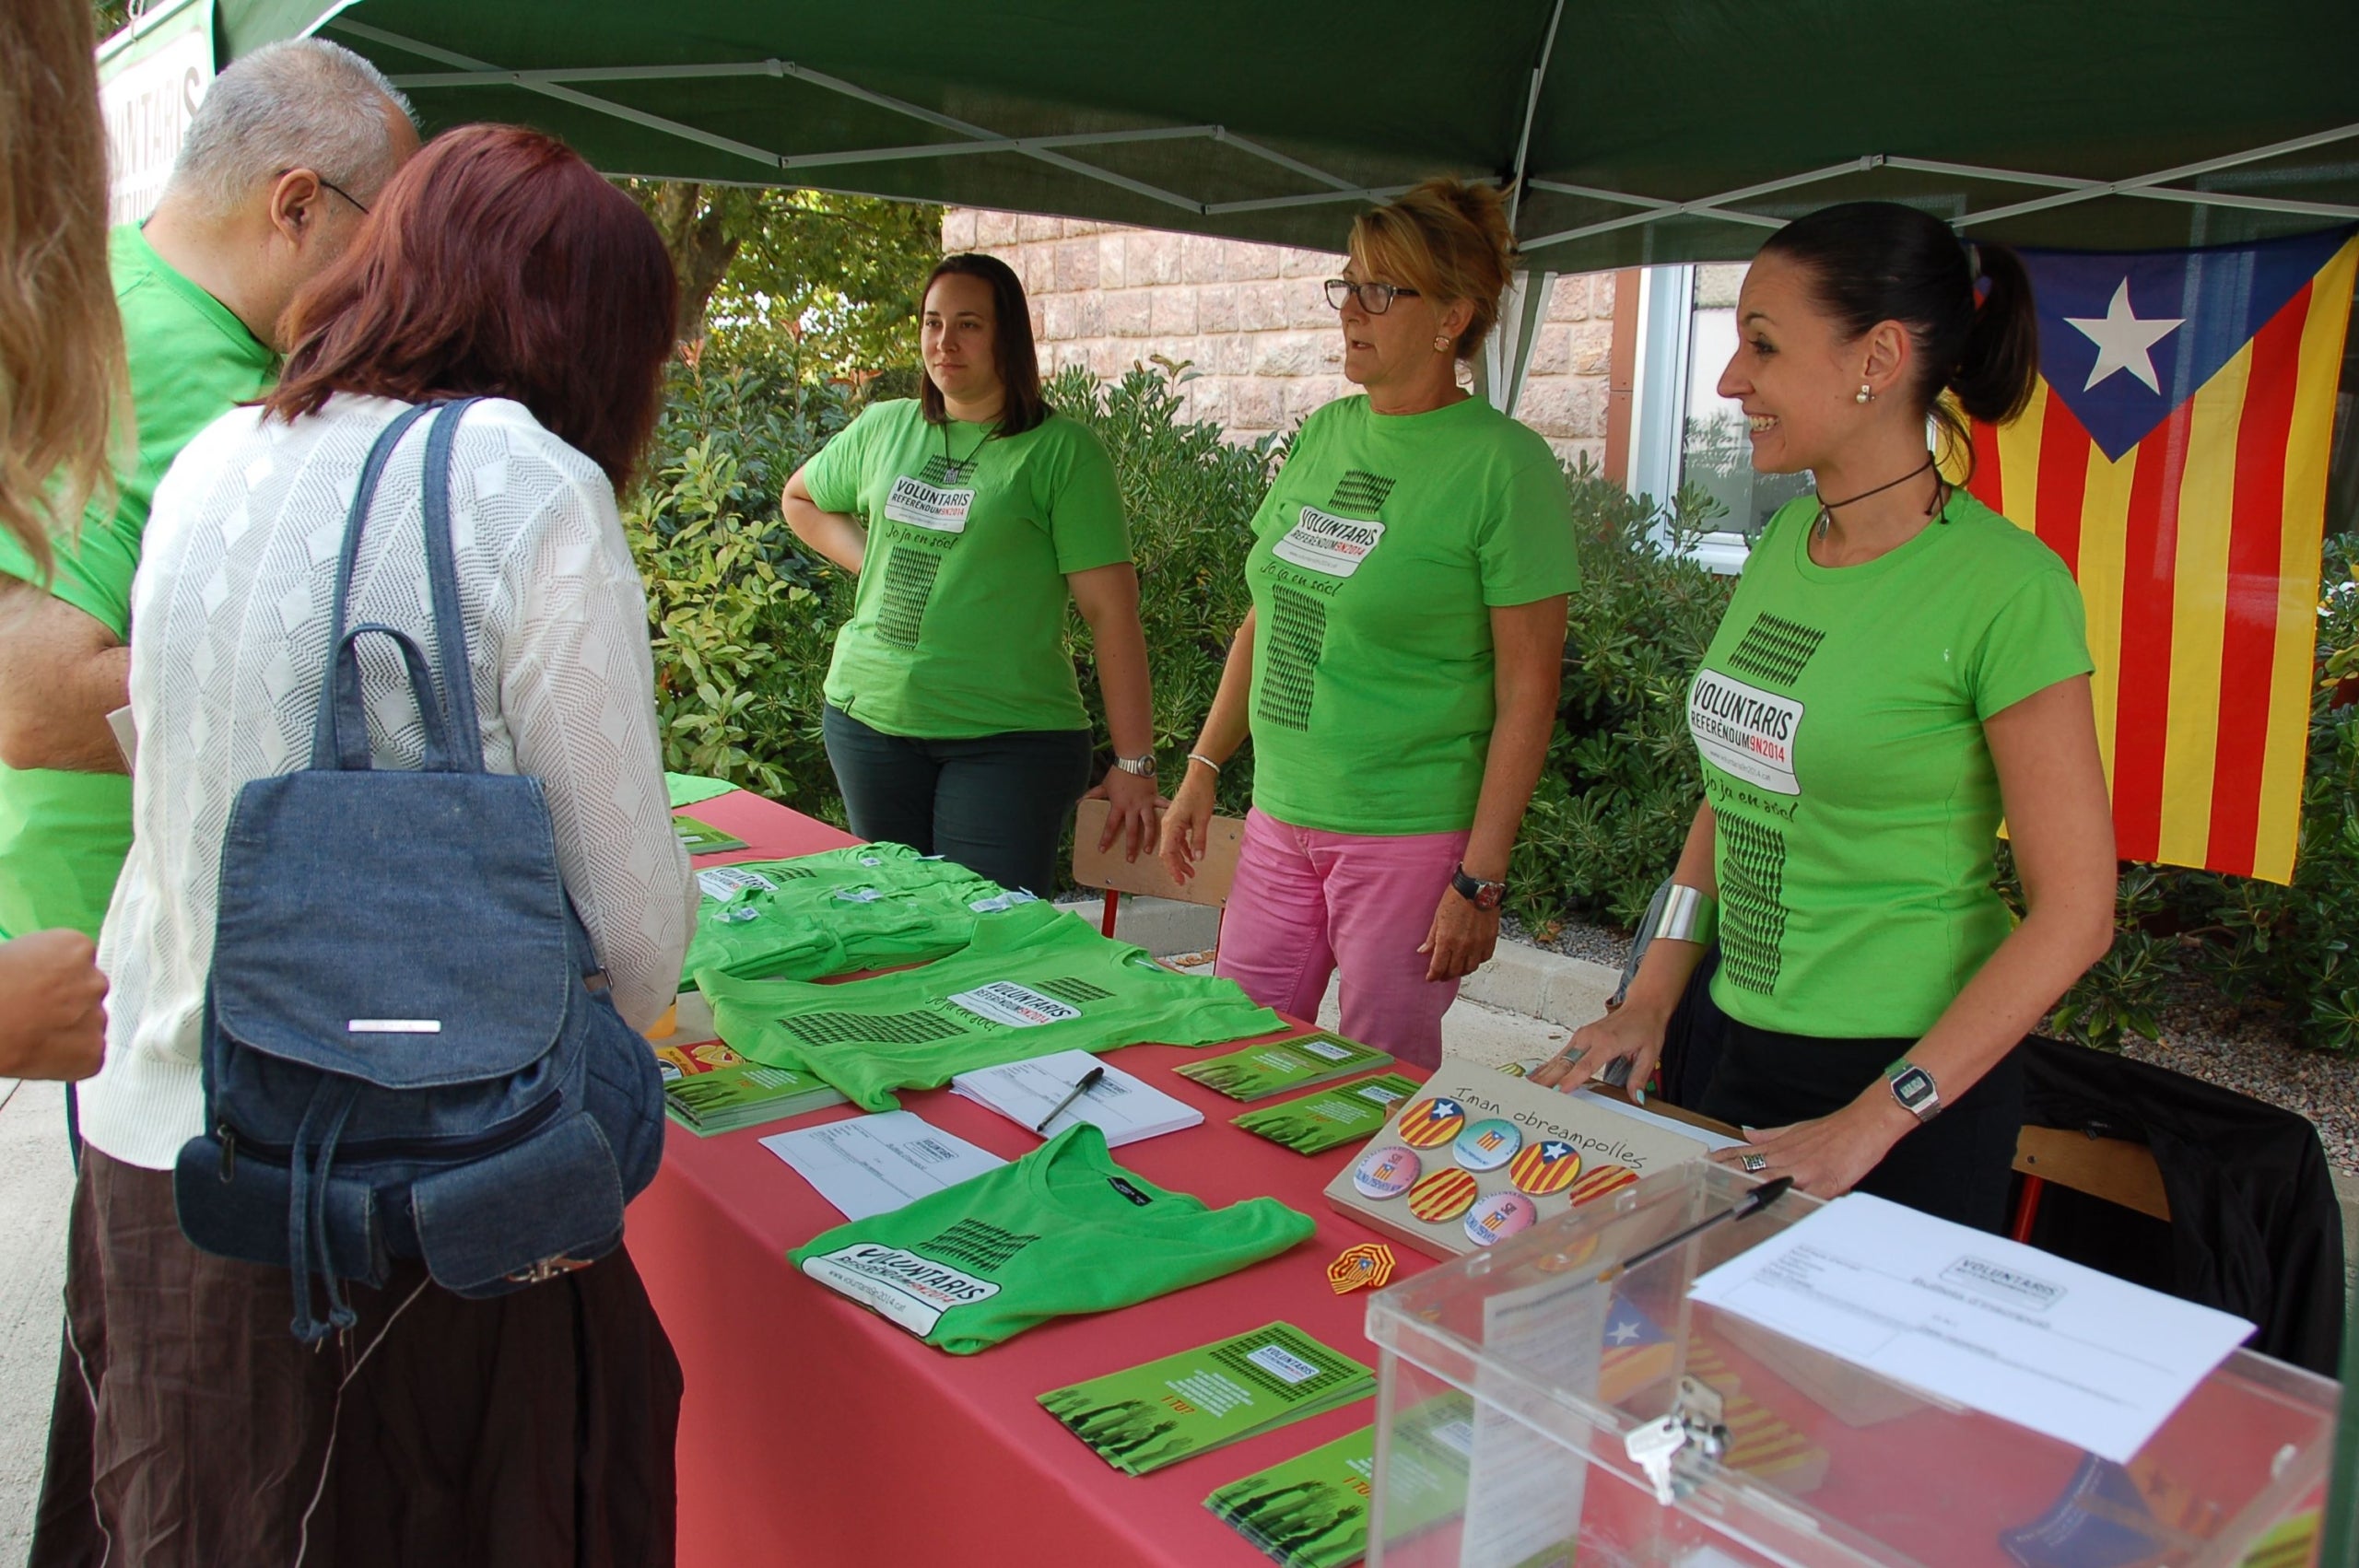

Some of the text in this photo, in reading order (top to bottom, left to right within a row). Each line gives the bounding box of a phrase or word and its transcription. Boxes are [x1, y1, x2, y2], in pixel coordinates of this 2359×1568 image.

[897, 480, 969, 506] VOLUNTARIS
[886, 524, 958, 550] Jo ja en sóc!
[1302, 509, 1378, 545] VOLUNTARIS
[1694, 678, 1793, 741] VOLUNTARIS
[1719, 777, 1733, 802] ja
[988, 982, 1072, 1017] VOLUNTARIS
[1449, 1087, 1500, 1115] Iman
[1513, 1111, 1648, 1169] obreampolles
[1963, 1259, 2055, 1295] VOLUNTARIS
[1265, 1346, 1316, 1375] VOLUNTARIS
[1168, 1399, 1196, 1415] TU?
[1352, 1481, 1371, 1498] TU
